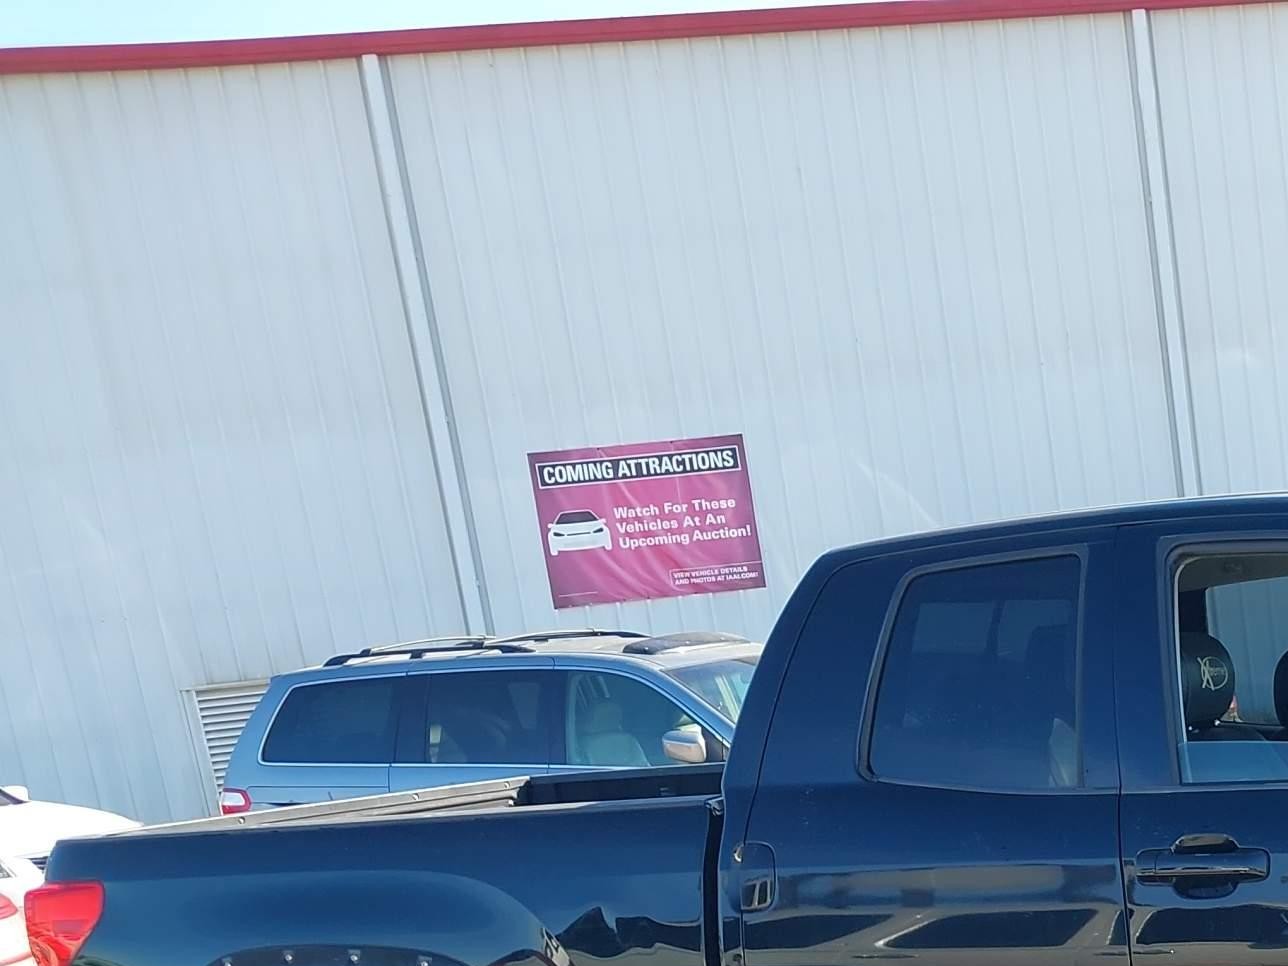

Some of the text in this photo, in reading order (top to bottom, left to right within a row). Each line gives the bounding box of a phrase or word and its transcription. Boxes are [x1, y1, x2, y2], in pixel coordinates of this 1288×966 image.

[543, 450, 734, 484] COMING ATTRACTIONS
[613, 498, 736, 519] Watch For These
[615, 513, 726, 534] Vehicles At An
[618, 524, 752, 549] Upcoming Auction!
[690, 576, 716, 584] PHOTOS
[691, 569, 719, 577] VEHICLE
[720, 566, 748, 574] DETAILS
